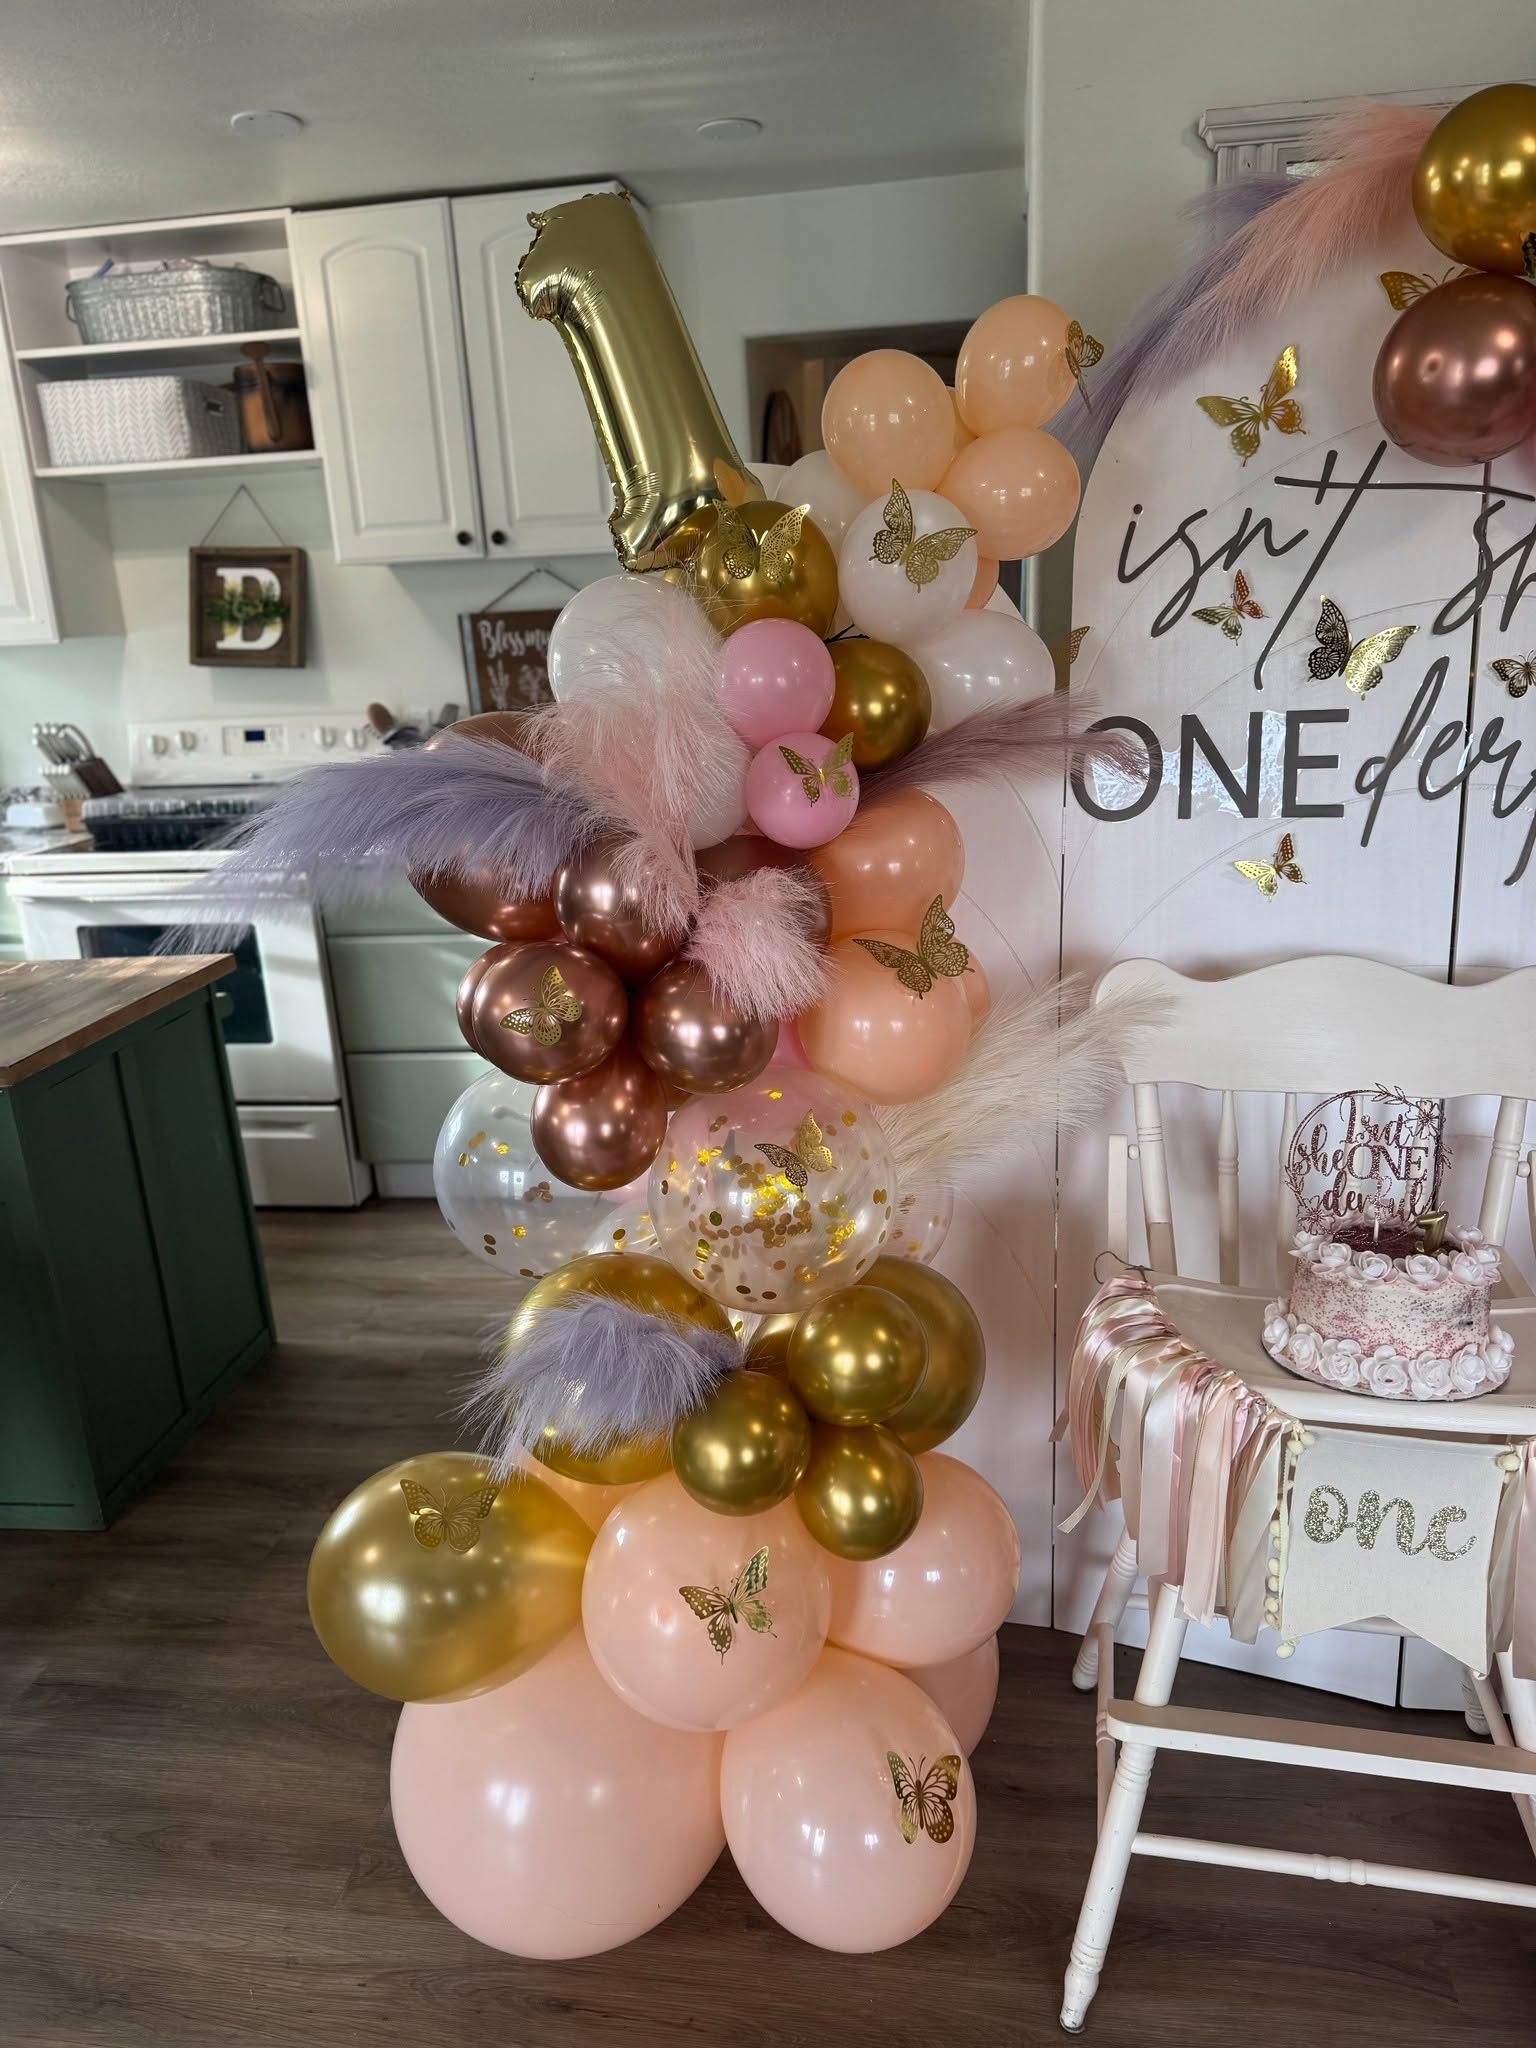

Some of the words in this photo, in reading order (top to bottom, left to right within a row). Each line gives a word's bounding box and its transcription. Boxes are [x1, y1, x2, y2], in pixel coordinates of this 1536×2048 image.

[215, 566, 283, 651] B
[477, 618, 527, 659] Bless
[1297, 1123, 1348, 1177] she
[1348, 1143, 1429, 1181] ONE
[1303, 1484, 1478, 1562] one
